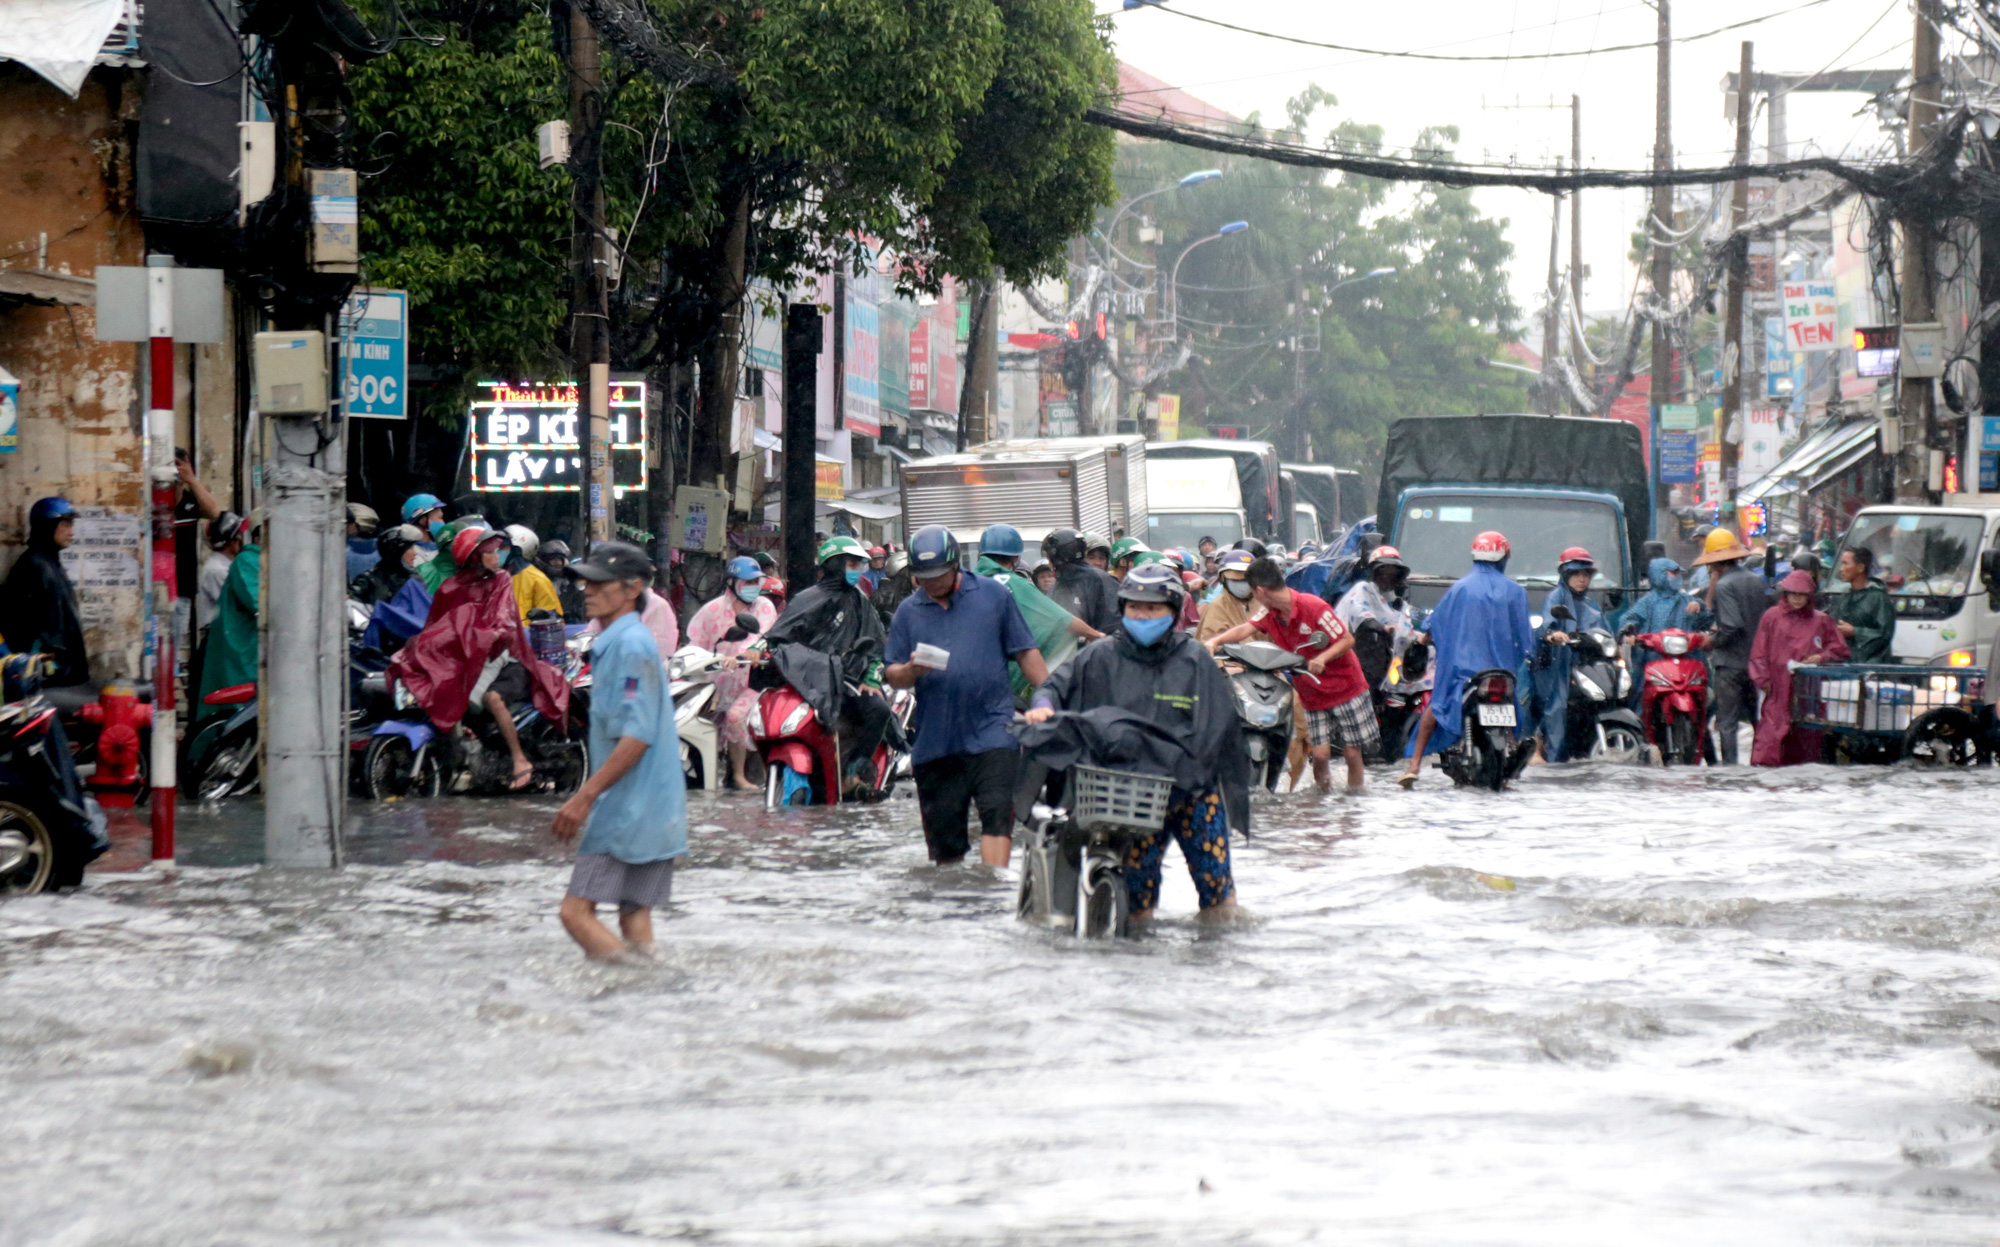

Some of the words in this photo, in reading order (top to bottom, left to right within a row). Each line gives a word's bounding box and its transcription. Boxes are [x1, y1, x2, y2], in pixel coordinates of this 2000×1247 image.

[1808, 285, 1834, 297] Trang
[1788, 321, 1834, 348] TEN
[363, 340, 390, 360] KÍNH
[910, 362, 928, 375] NG
[341, 373, 398, 413] GỌC
[488, 407, 530, 444] ÉP
[539, 407, 627, 444] KÍH
